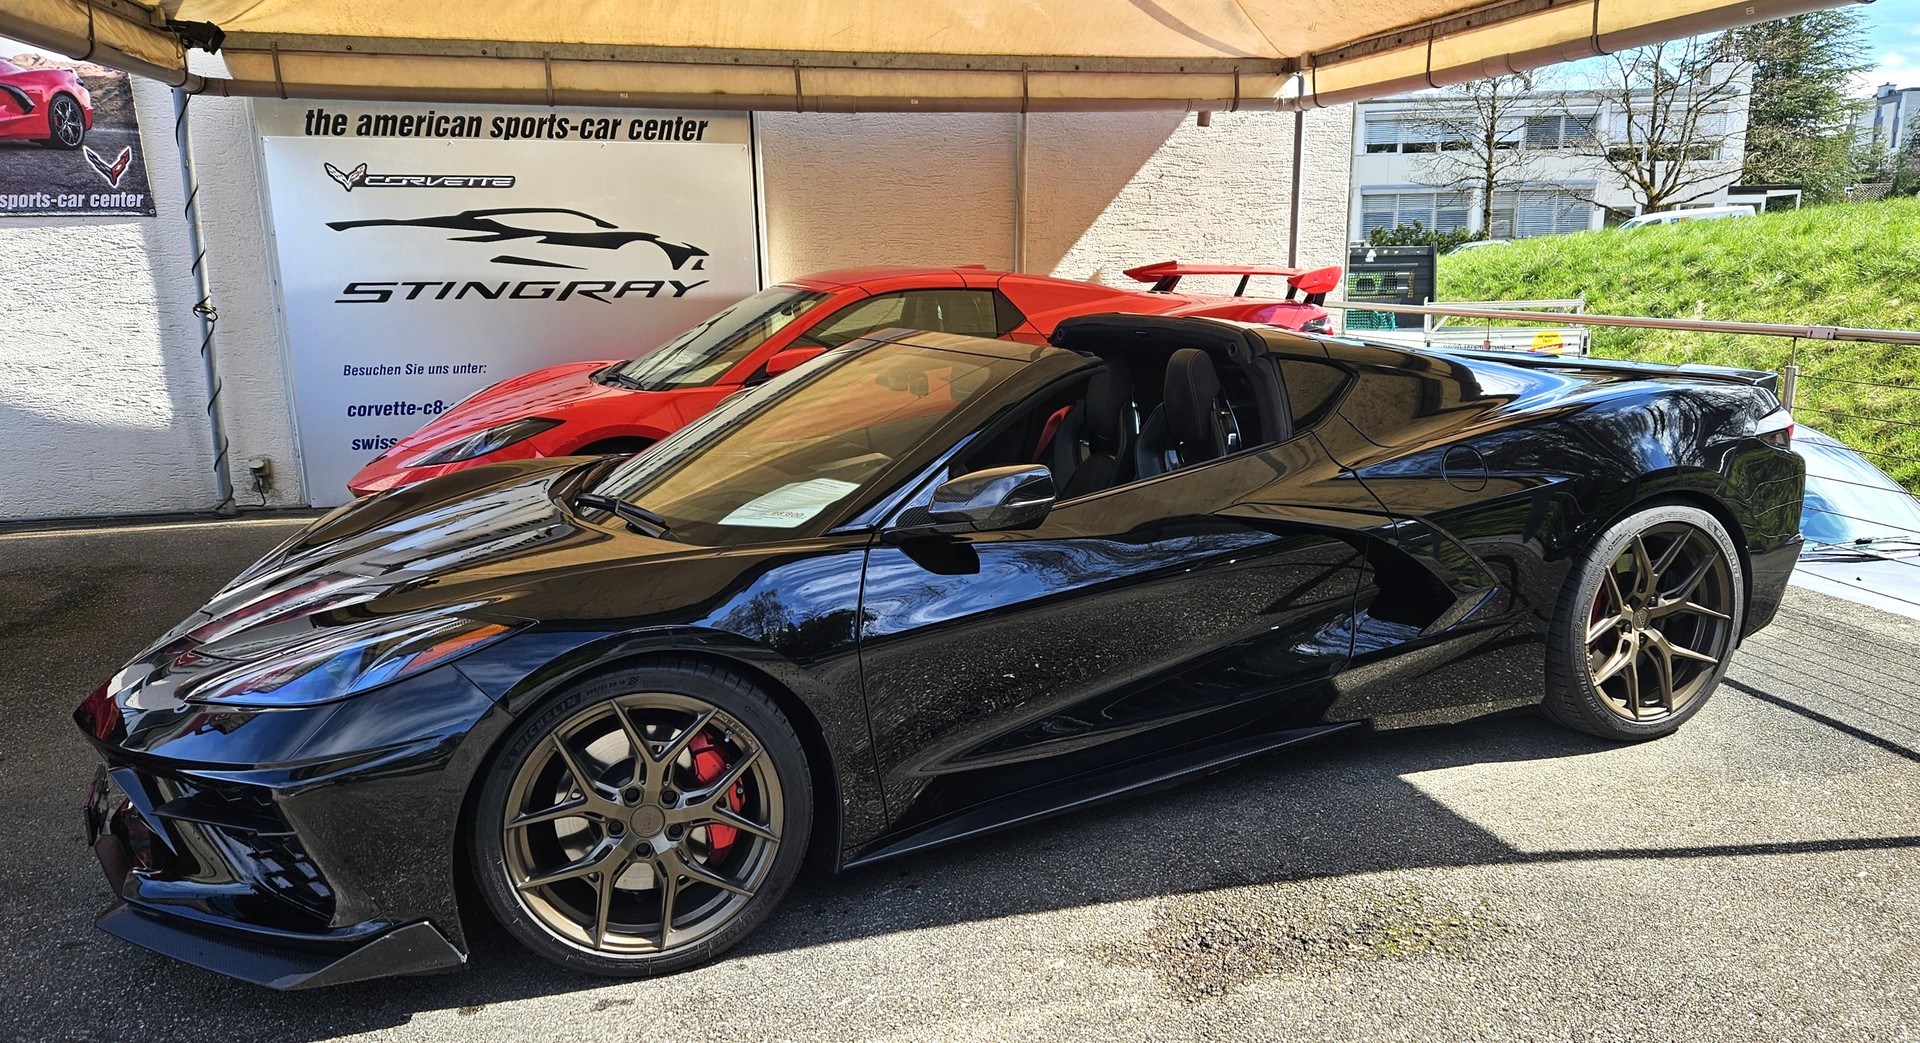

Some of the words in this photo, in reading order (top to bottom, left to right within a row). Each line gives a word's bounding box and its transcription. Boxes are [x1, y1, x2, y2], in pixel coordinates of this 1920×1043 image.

[305, 109, 348, 136] the
[356, 110, 483, 138] american
[490, 113, 622, 140] sports-car
[628, 116, 708, 141] center
[364, 175, 514, 187] CORVETTE
[0, 192, 85, 210] sports-car
[90, 192, 143, 208] center
[334, 280, 710, 304] STINGRAY
[343, 364, 401, 376] Besuchen
[405, 363, 424, 375] Sie
[428, 365, 449, 375] uns
[453, 363, 487, 374] unter:
[347, 400, 456, 417] corvette-c8-
[514, 695, 578, 750] MICHELIN
